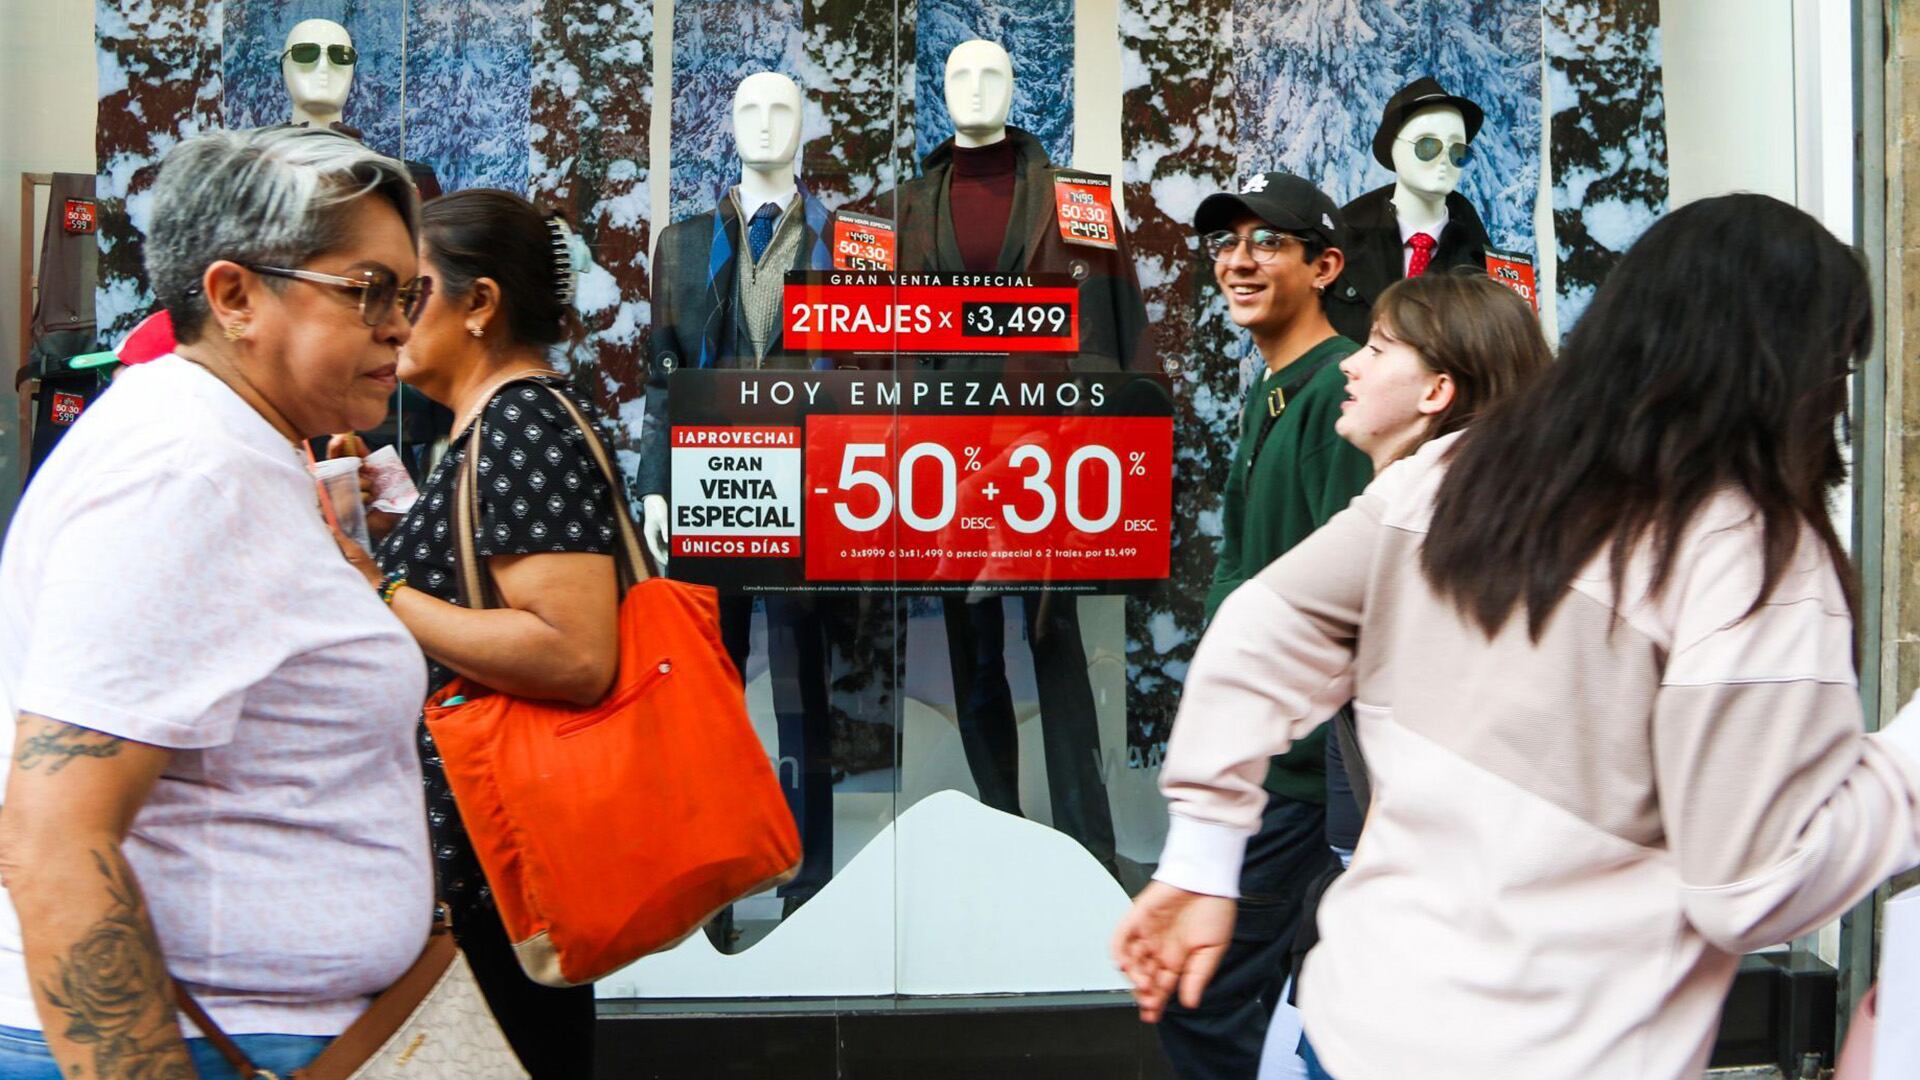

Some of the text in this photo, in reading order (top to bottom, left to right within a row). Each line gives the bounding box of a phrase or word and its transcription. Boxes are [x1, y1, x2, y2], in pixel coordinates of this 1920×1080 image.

[1070, 220, 1109, 240] 2499
[852, 257, 887, 271] 1574
[831, 274, 1034, 287] GRAN VENTA ESPECIAL
[968, 305, 1066, 336] $3,499
[740, 381, 1105, 407] HOY EMPEZAMOS
[679, 431, 794, 444] ¡APROVECHA!
[708, 456, 762, 471] GRAN
[700, 479, 778, 500] VENTA
[677, 505, 795, 528] ESPECIAL
[961, 517, 995, 530] DESC.
[1124, 520, 1158, 532] DESC.
[682, 538, 790, 554] ÚNICOS DÍAS
[956, 549, 988, 559] precio
[991, 548, 1033, 559] especial
[1055, 548, 1082, 559] trajes
[1085, 550, 1102, 559] por
